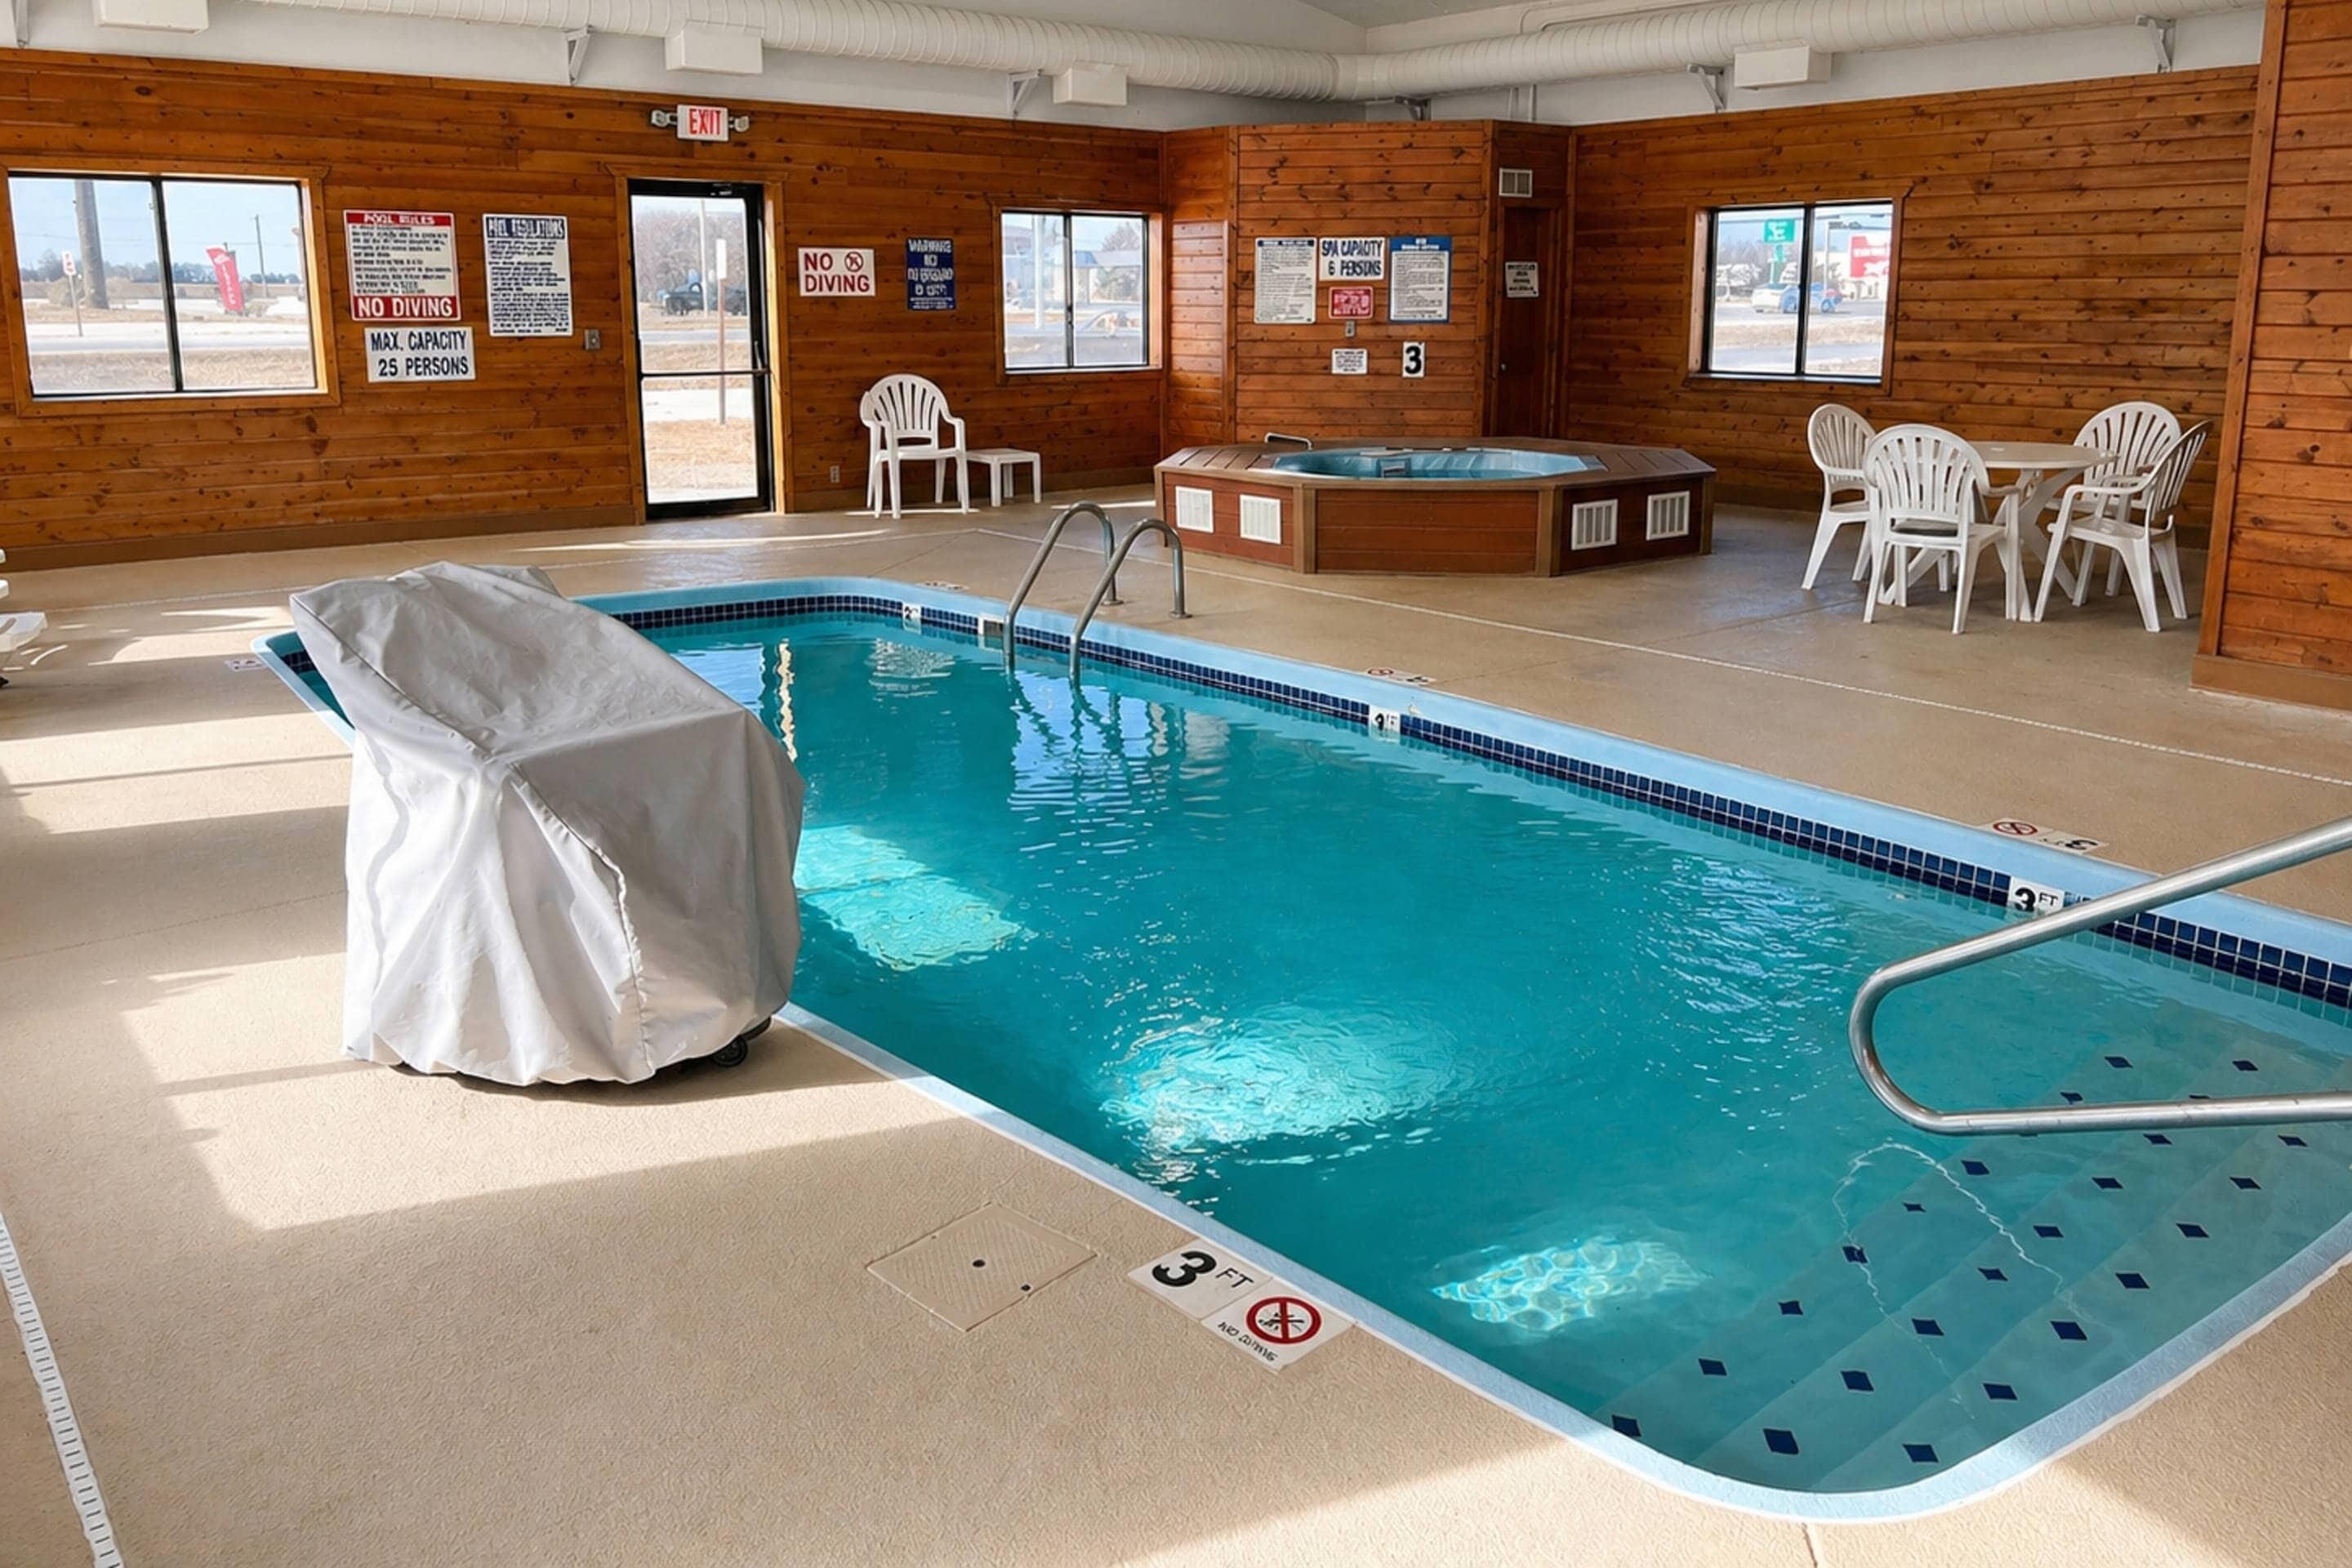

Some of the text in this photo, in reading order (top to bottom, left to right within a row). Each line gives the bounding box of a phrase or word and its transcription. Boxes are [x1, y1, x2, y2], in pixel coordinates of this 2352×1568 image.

[688, 108, 721, 136] EXIT
[804, 252, 833, 271] NO
[804, 274, 870, 292] DIVING
[356, 297, 453, 317] NO DIVING
[371, 331, 466, 351] MAX. CAPACITY
[378, 356, 469, 376] 25 PERSONS
[1405, 345, 1421, 375] 3
[2015, 887, 2059, 912] 3 FT
[1152, 1250, 1254, 1288] 3 FT
